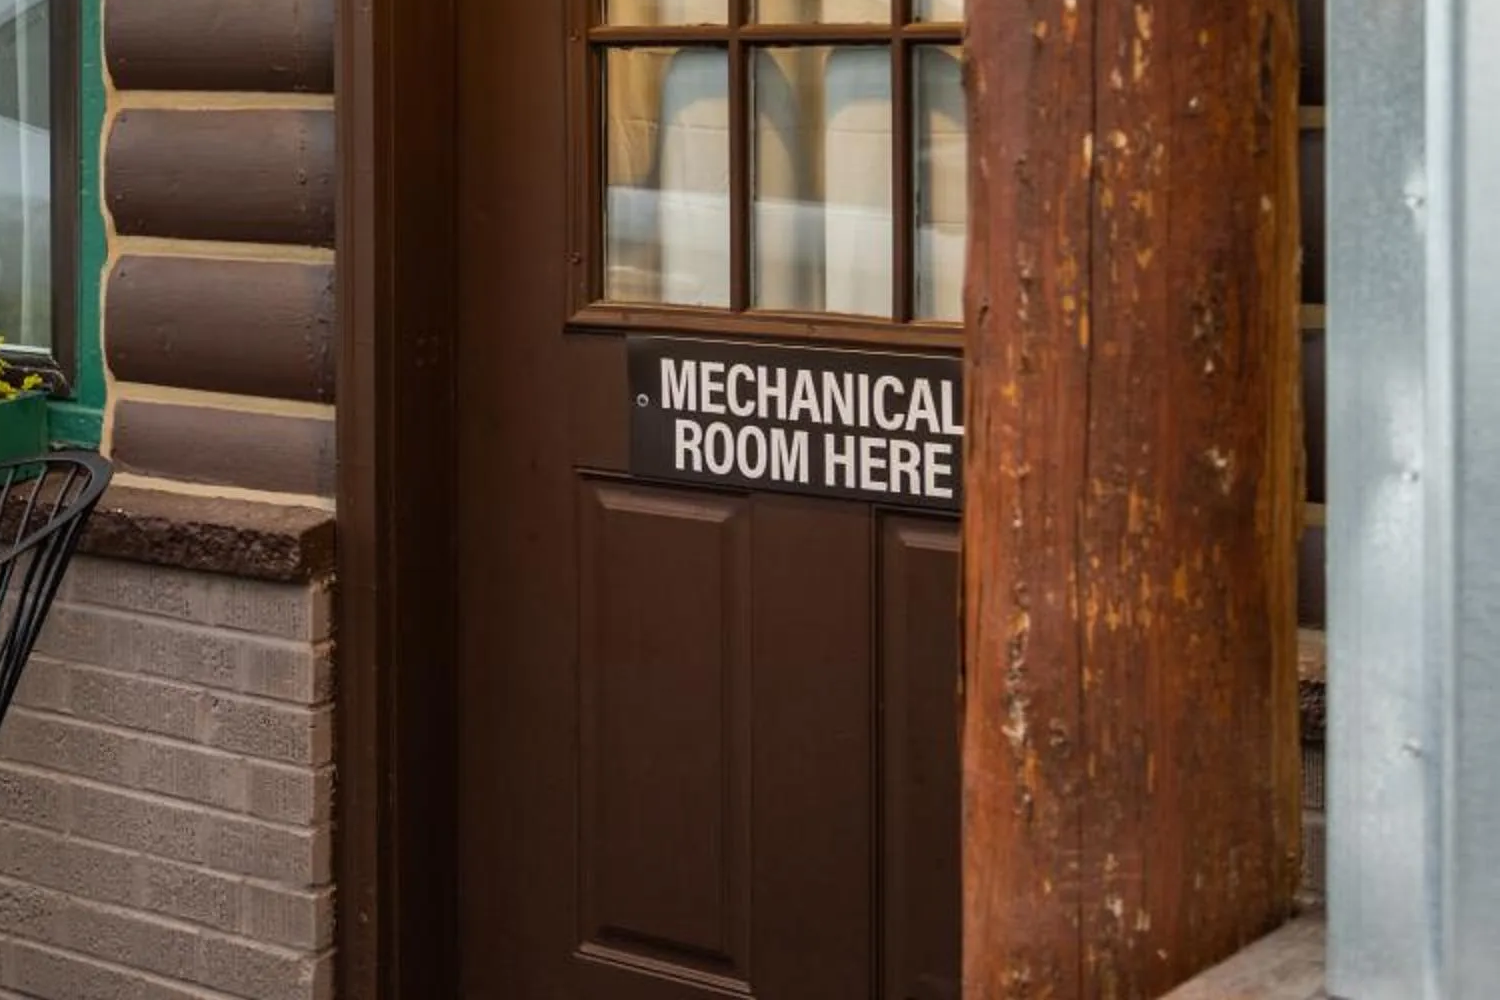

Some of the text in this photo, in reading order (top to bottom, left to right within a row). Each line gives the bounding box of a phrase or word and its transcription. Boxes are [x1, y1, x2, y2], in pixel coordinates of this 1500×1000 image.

[660, 358, 965, 435] MECHANICAL
[674, 419, 954, 499] ROOM HERE
